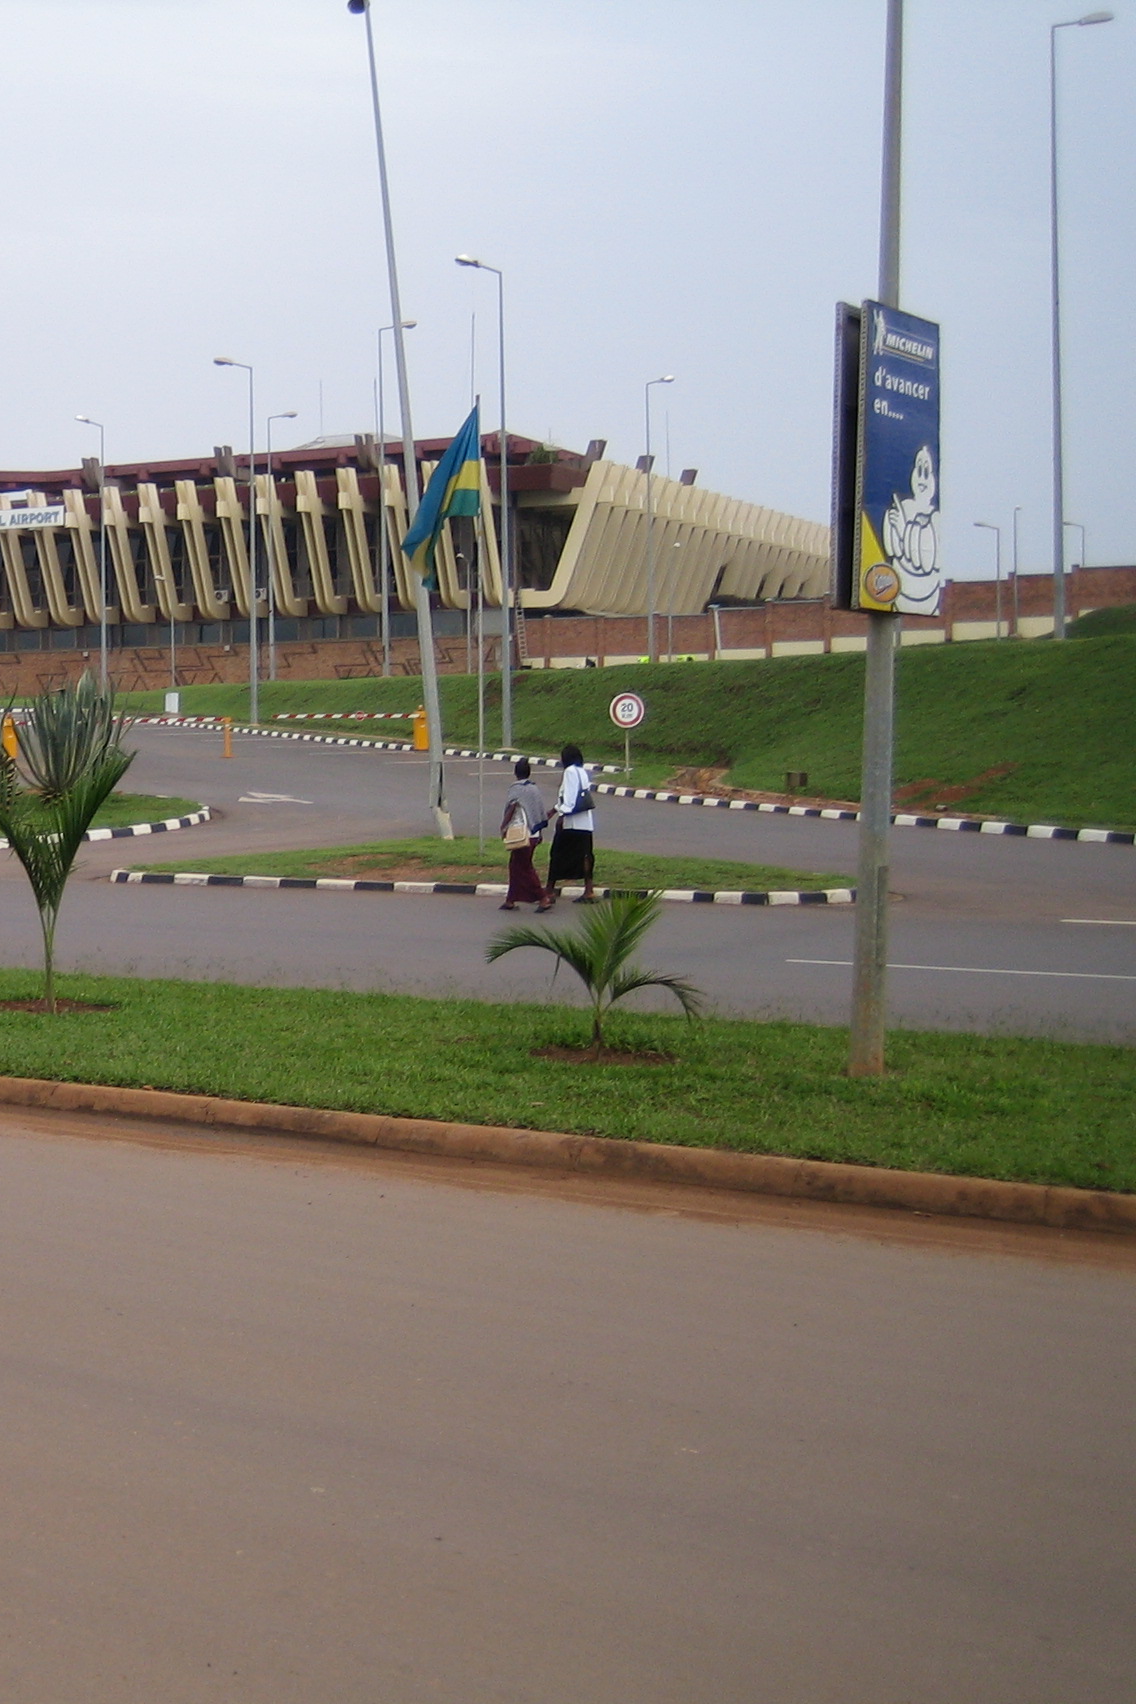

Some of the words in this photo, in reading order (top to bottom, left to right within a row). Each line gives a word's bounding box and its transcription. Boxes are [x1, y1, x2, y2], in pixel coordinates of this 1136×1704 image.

[885, 333, 934, 359] MICHELIN
[874, 365, 930, 400] d'avancer
[9, 510, 60, 526] AIRPORT
[620, 702, 634, 713] 20
